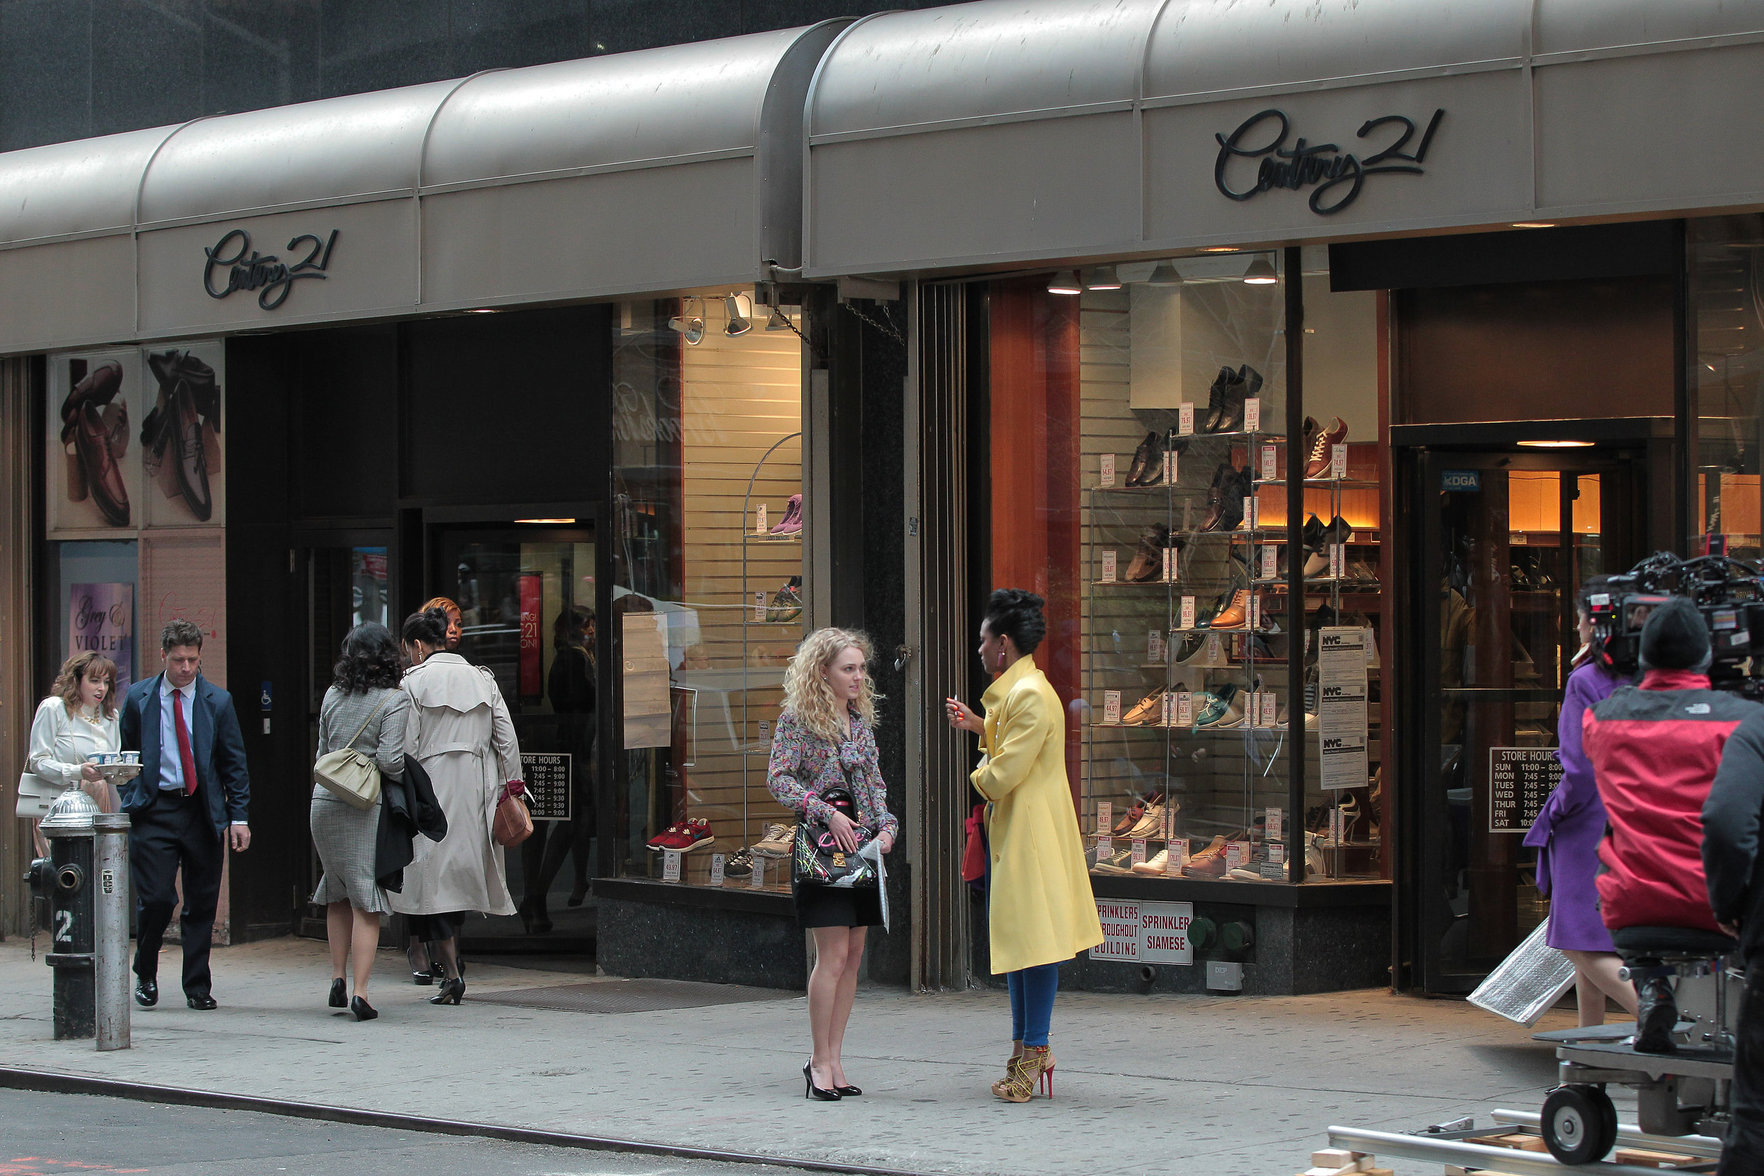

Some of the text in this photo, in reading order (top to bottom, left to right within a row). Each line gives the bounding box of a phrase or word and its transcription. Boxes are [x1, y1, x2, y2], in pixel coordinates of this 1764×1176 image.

[1215, 108, 1445, 215] Century 21
[204, 229, 339, 311] Century 21
[75, 635, 127, 651] VIOLET
[1322, 635, 1341, 645] NYC
[1323, 687, 1342, 696] NYC
[1323, 739, 1342, 749] NYC
[538, 756, 561, 764] HOURS
[1502, 751, 1555, 761] STORE HOUR
[1495, 763, 1511, 771] SUN
[1521, 763, 1540, 771] 11:00
[1495, 772, 1515, 780] MON
[1524, 772, 1538, 780] 7:45
[1495, 781, 1514, 789] TUES
[1524, 781, 1538, 789] 7:45
[1495, 790, 1514, 798] WED
[1524, 791, 1538, 799] 7:45
[1494, 800, 1516, 808] THUR
[1523, 800, 1538, 808] 7:45
[1523, 809, 1538, 818] 7:45
[1494, 819, 1509, 827] SAT
[55, 910, 72, 942] 2
[1142, 915, 1190, 930] SPRINKLER
[1147, 936, 1185, 951] SIAMESE
